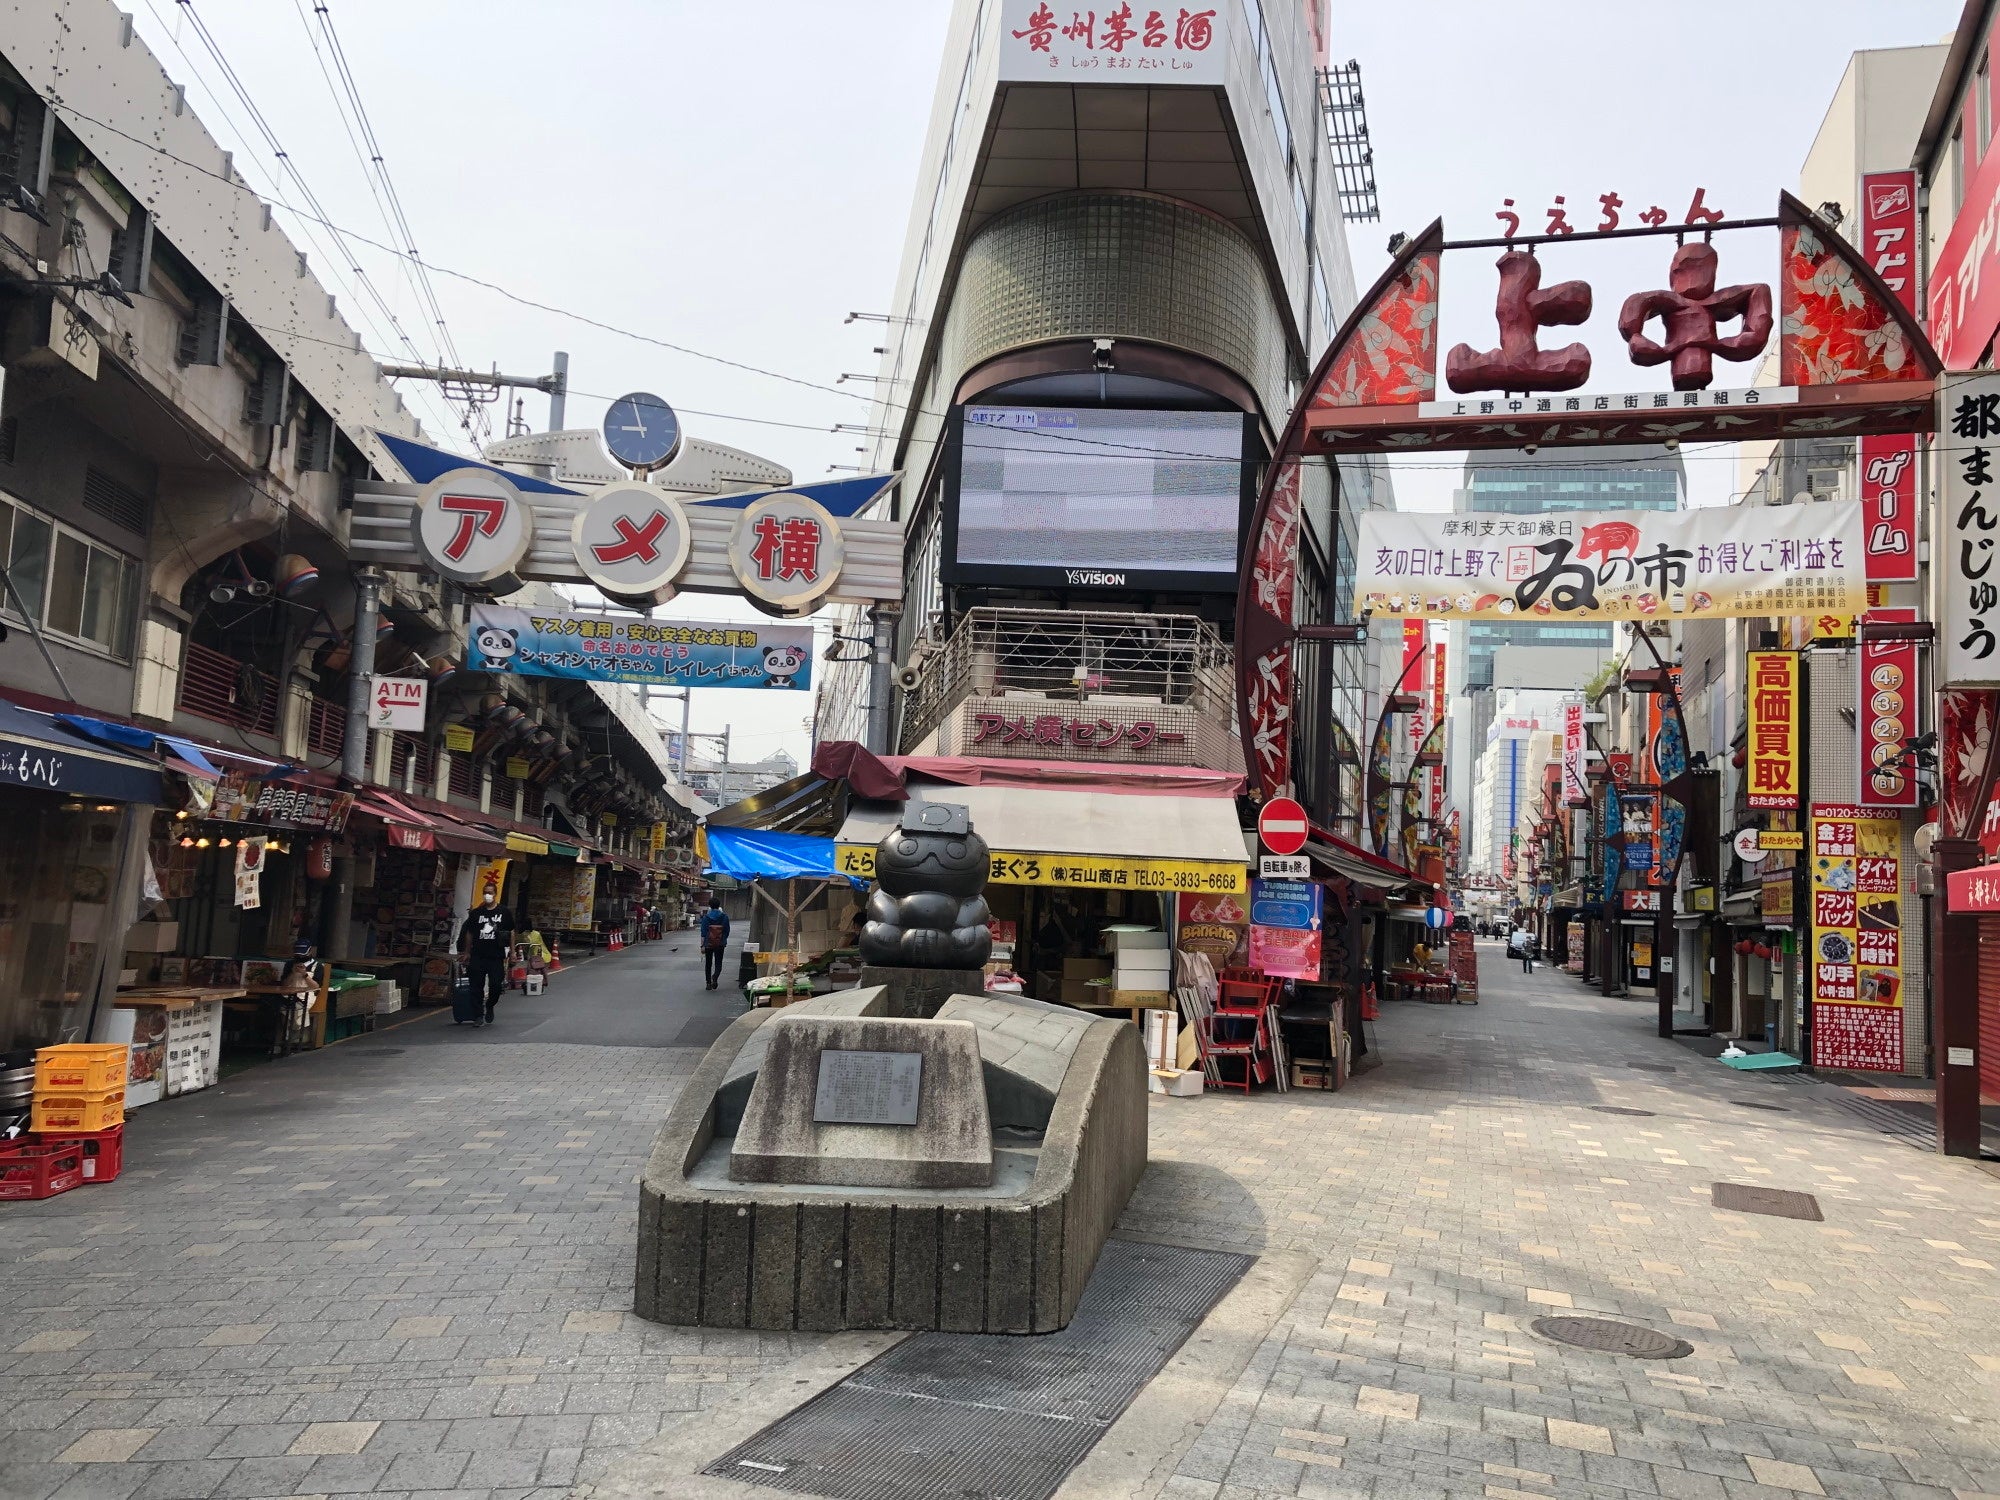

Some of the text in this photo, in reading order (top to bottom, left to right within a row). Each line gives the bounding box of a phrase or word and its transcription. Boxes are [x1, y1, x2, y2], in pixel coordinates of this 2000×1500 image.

[1452, 389, 1760, 415] 上野中通商店街振興組合
[1866, 451, 1911, 555] ゲーム
[1442, 519, 1573, 537] 摩利支天御縁日
[1952, 393, 2000, 659] 都まんじゅう
[440, 494, 822, 584] アメ横
[1375, 546, 1504, 577] 亥の日は上野で
[1698, 537, 1845, 573] お得とご利益を
[1080, 573, 1125, 585] VISION
[1603, 584, 1639, 595] INOICHI
[582, 639, 690, 659] 命名おめでとう
[520, 647, 656, 672] シャオシャオちゃん
[1876, 671, 1898, 686] 4F
[378, 682, 421, 698] ATM
[1876, 695, 1898, 711] 3F
[975, 714, 1184, 749] アメ横センター
[1754, 655, 1792, 791] 高価買取
[1877, 721, 1899, 738] 2F
[18, 750, 62, 787] もへじ
[1878, 774, 1897, 790] B1
[1749, 796, 1796, 806] おたからや
[1825, 808, 1897, 819] 0120-555-600
[1818, 823, 1835, 841] 金
[845, 851, 876, 872] たら
[990, 858, 1041, 881] まぐろ
[1263, 860, 1308, 874] 自転車を除く
[1859, 859, 1896, 878] ダイヤ
[1632, 890, 1666, 910] 大黒
[1818, 893, 1854, 909] ブランド
[1818, 909, 1854, 926] バッグ
[1859, 931, 1897, 947] ブランド
[1860, 947, 1896, 964] 時計
[1819, 964, 1854, 983] 切手
